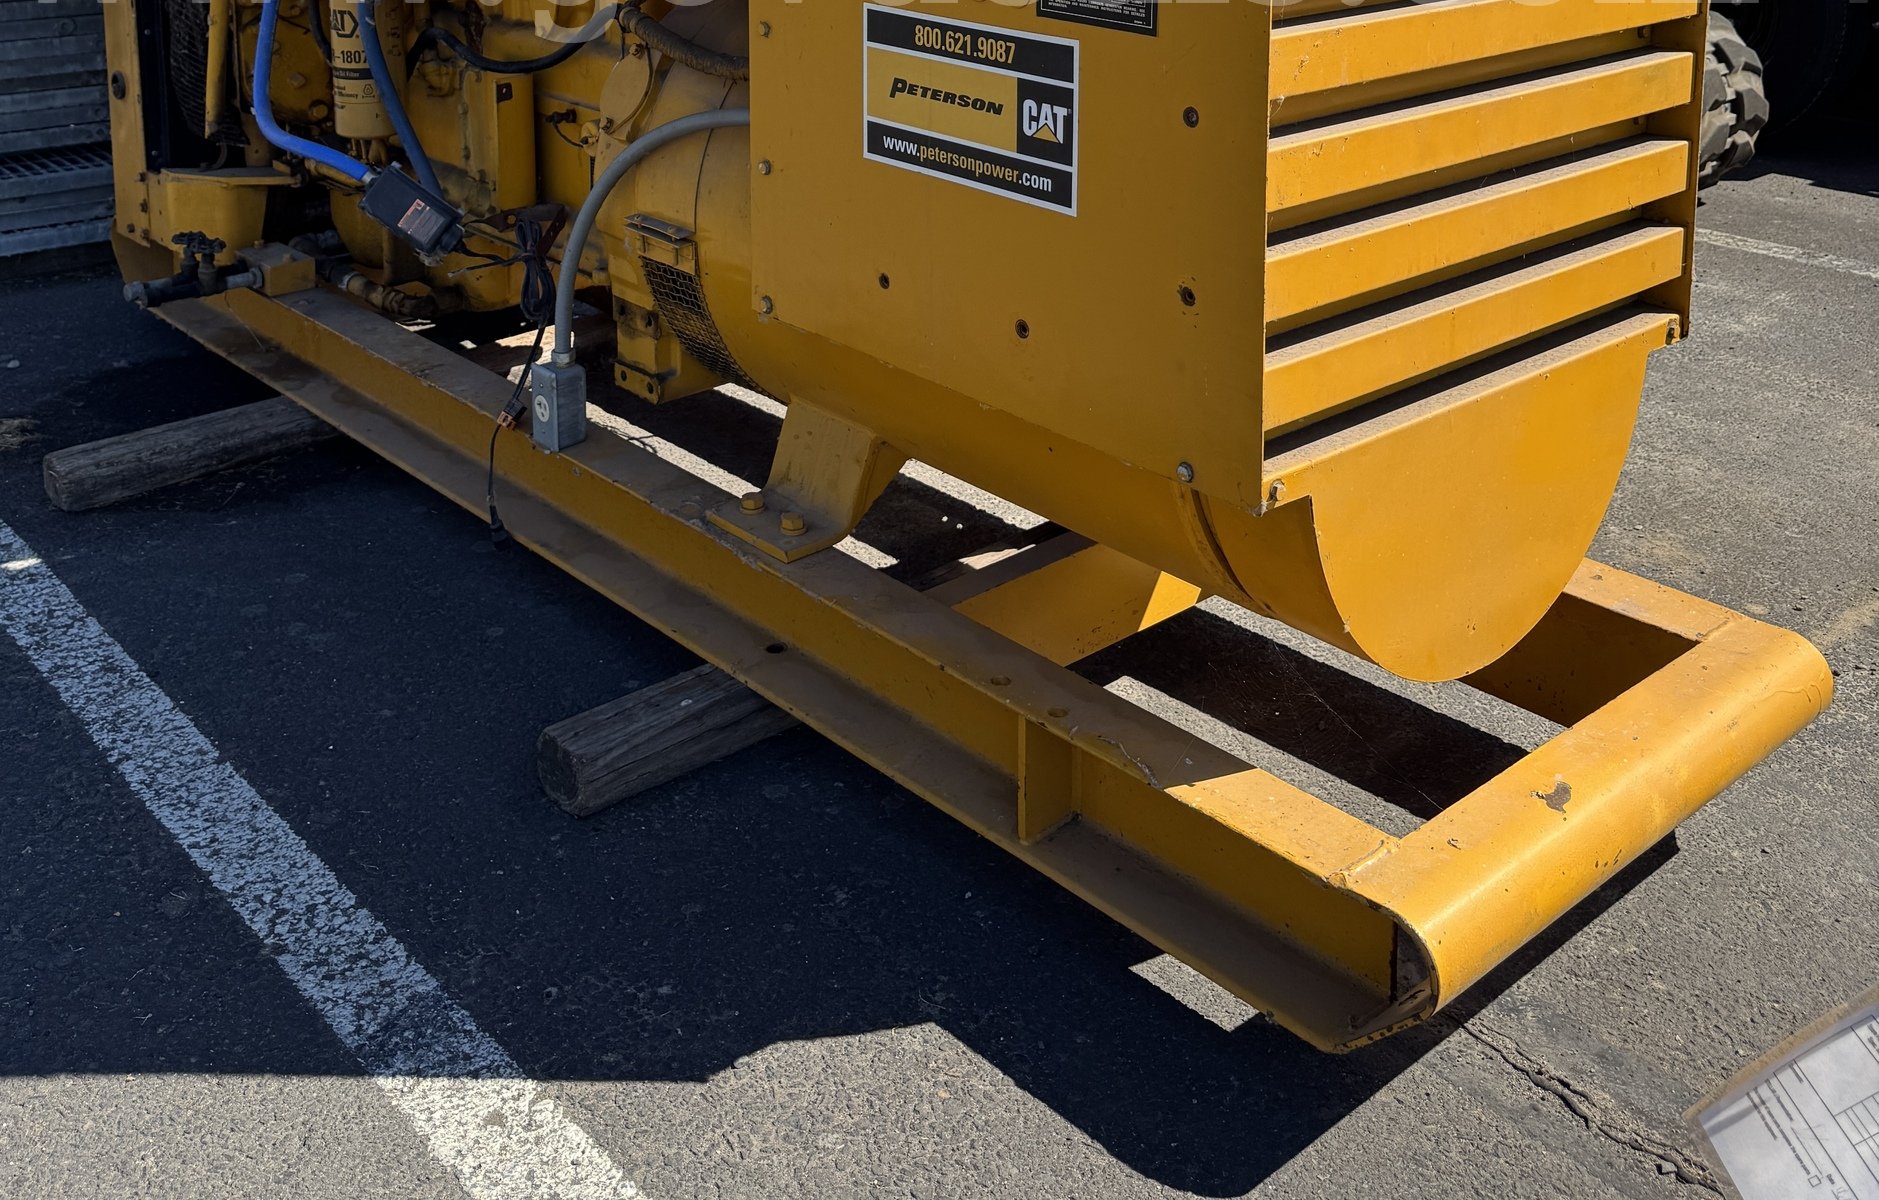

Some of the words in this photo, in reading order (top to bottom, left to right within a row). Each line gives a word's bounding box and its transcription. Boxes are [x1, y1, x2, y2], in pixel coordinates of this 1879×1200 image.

[915, 24, 1016, 63] 800.621.9087
[889, 77, 1003, 115] PETERSON
[1022, 99, 1068, 144] CAT
[883, 136, 1052, 192] www.petersonpower.com
